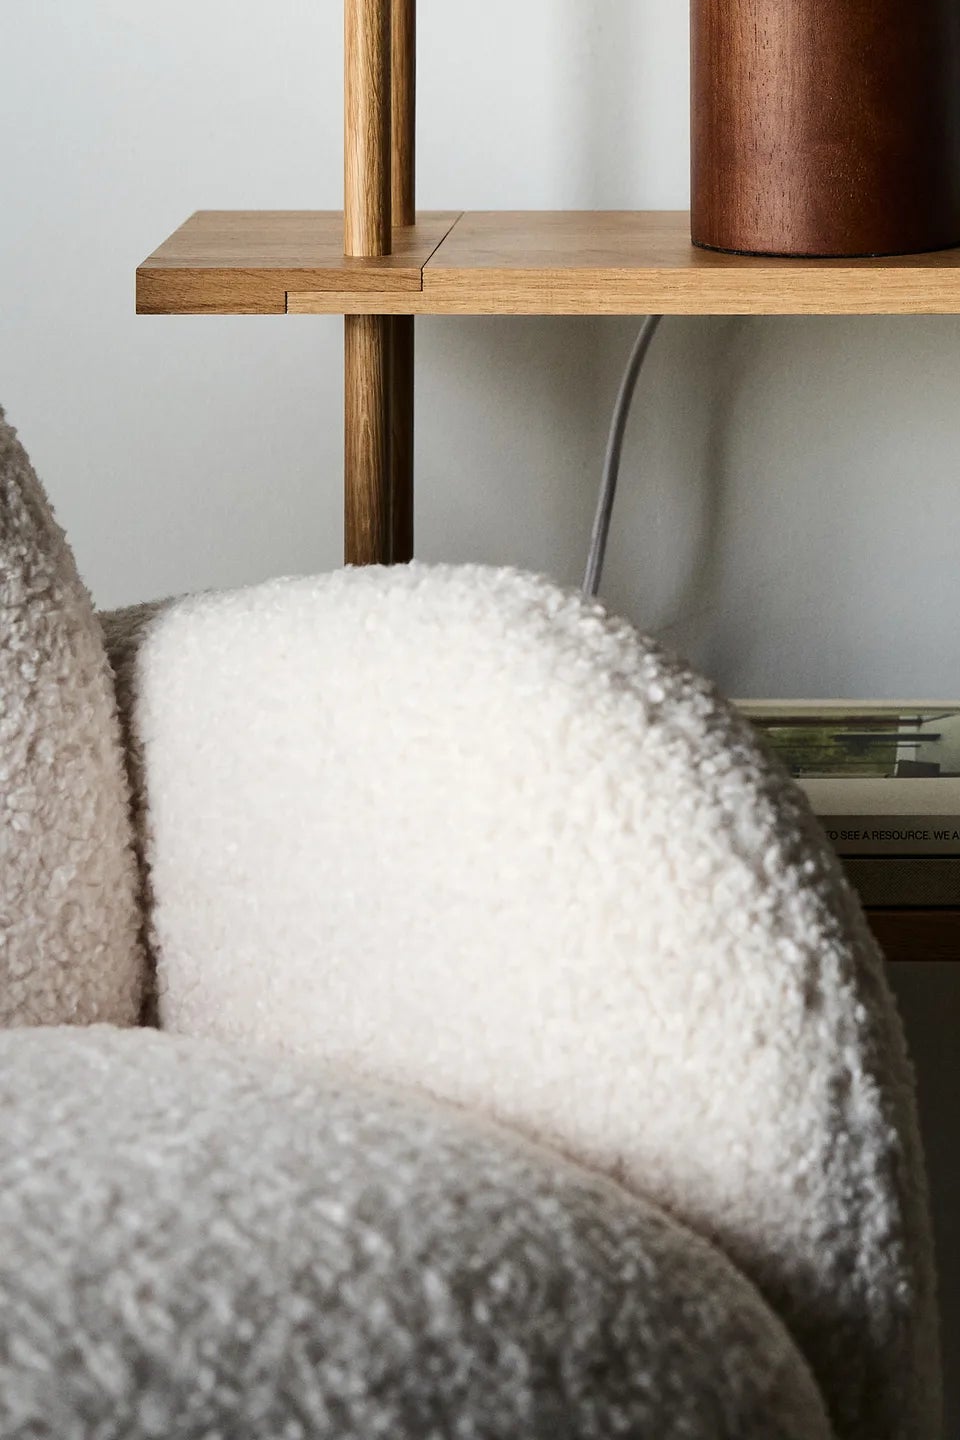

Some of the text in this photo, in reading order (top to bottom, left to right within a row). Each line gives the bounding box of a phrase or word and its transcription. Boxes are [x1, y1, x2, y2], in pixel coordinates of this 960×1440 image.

[840, 830, 860, 840] SEE
[862, 830, 871, 840] A
[872, 830, 931, 840] RESOURCE.
[933, 830, 950, 840] WE
